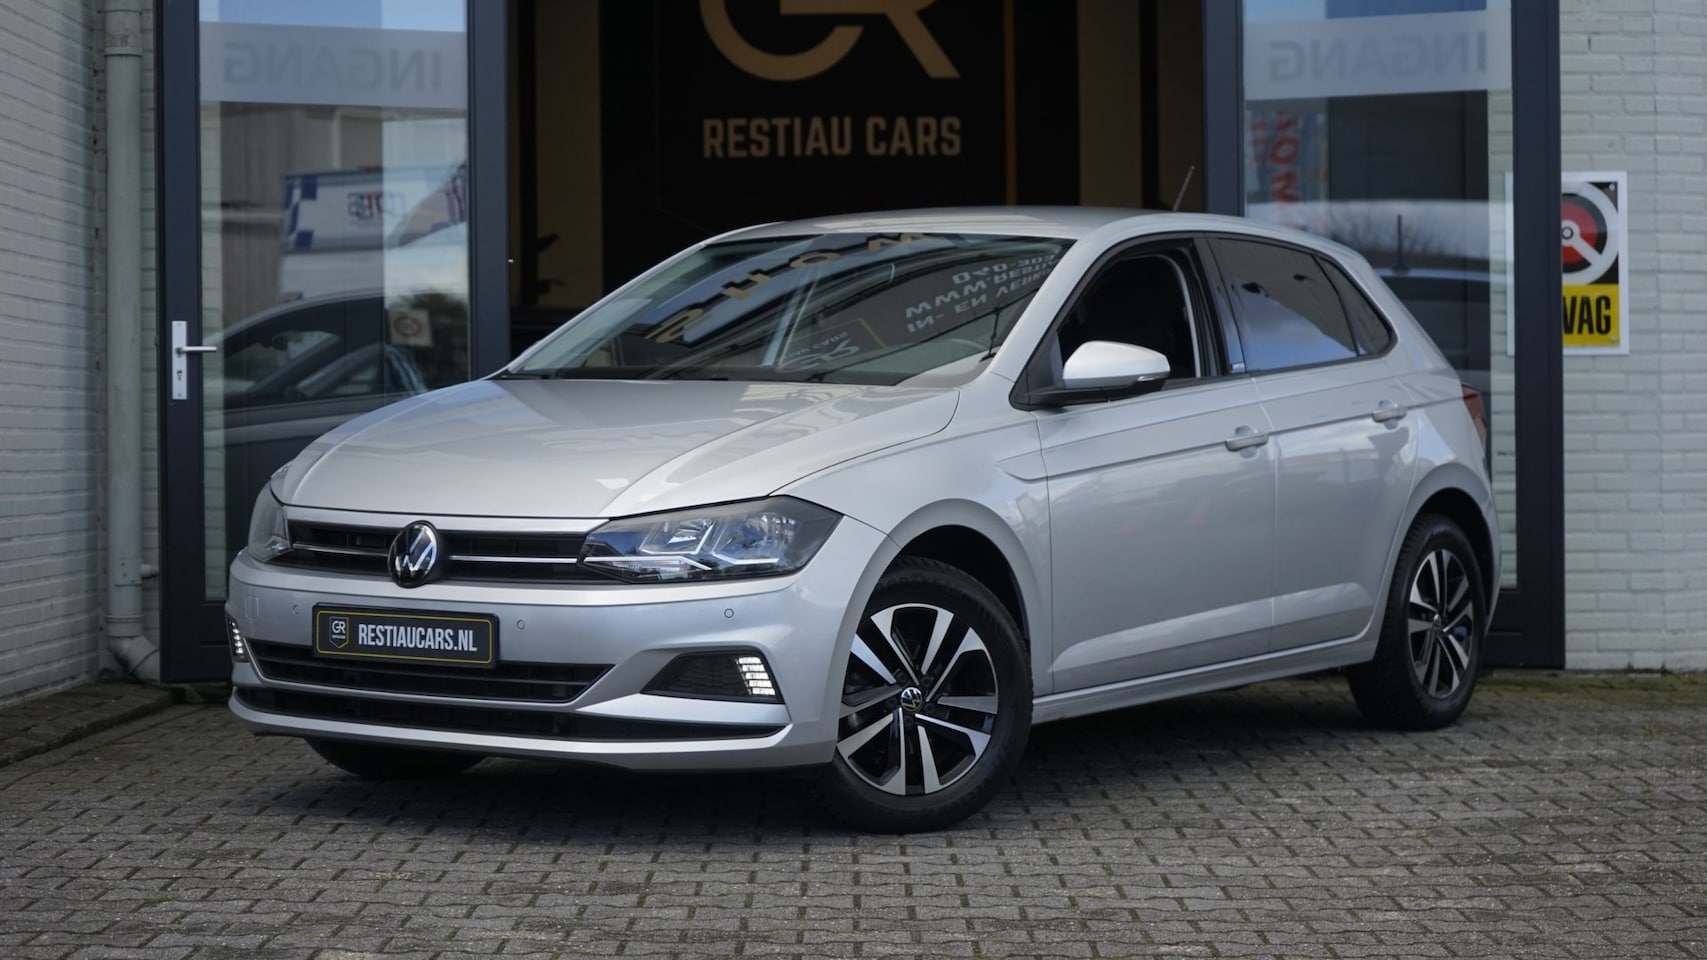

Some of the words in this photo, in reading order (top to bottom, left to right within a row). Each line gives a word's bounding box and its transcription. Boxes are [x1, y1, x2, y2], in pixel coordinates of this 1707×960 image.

[703, 116, 852, 158] RESTIAU
[865, 116, 962, 157] CARS
[1563, 295, 1611, 335] VAG
[358, 623, 478, 652] RESTIAUCARS.NL
